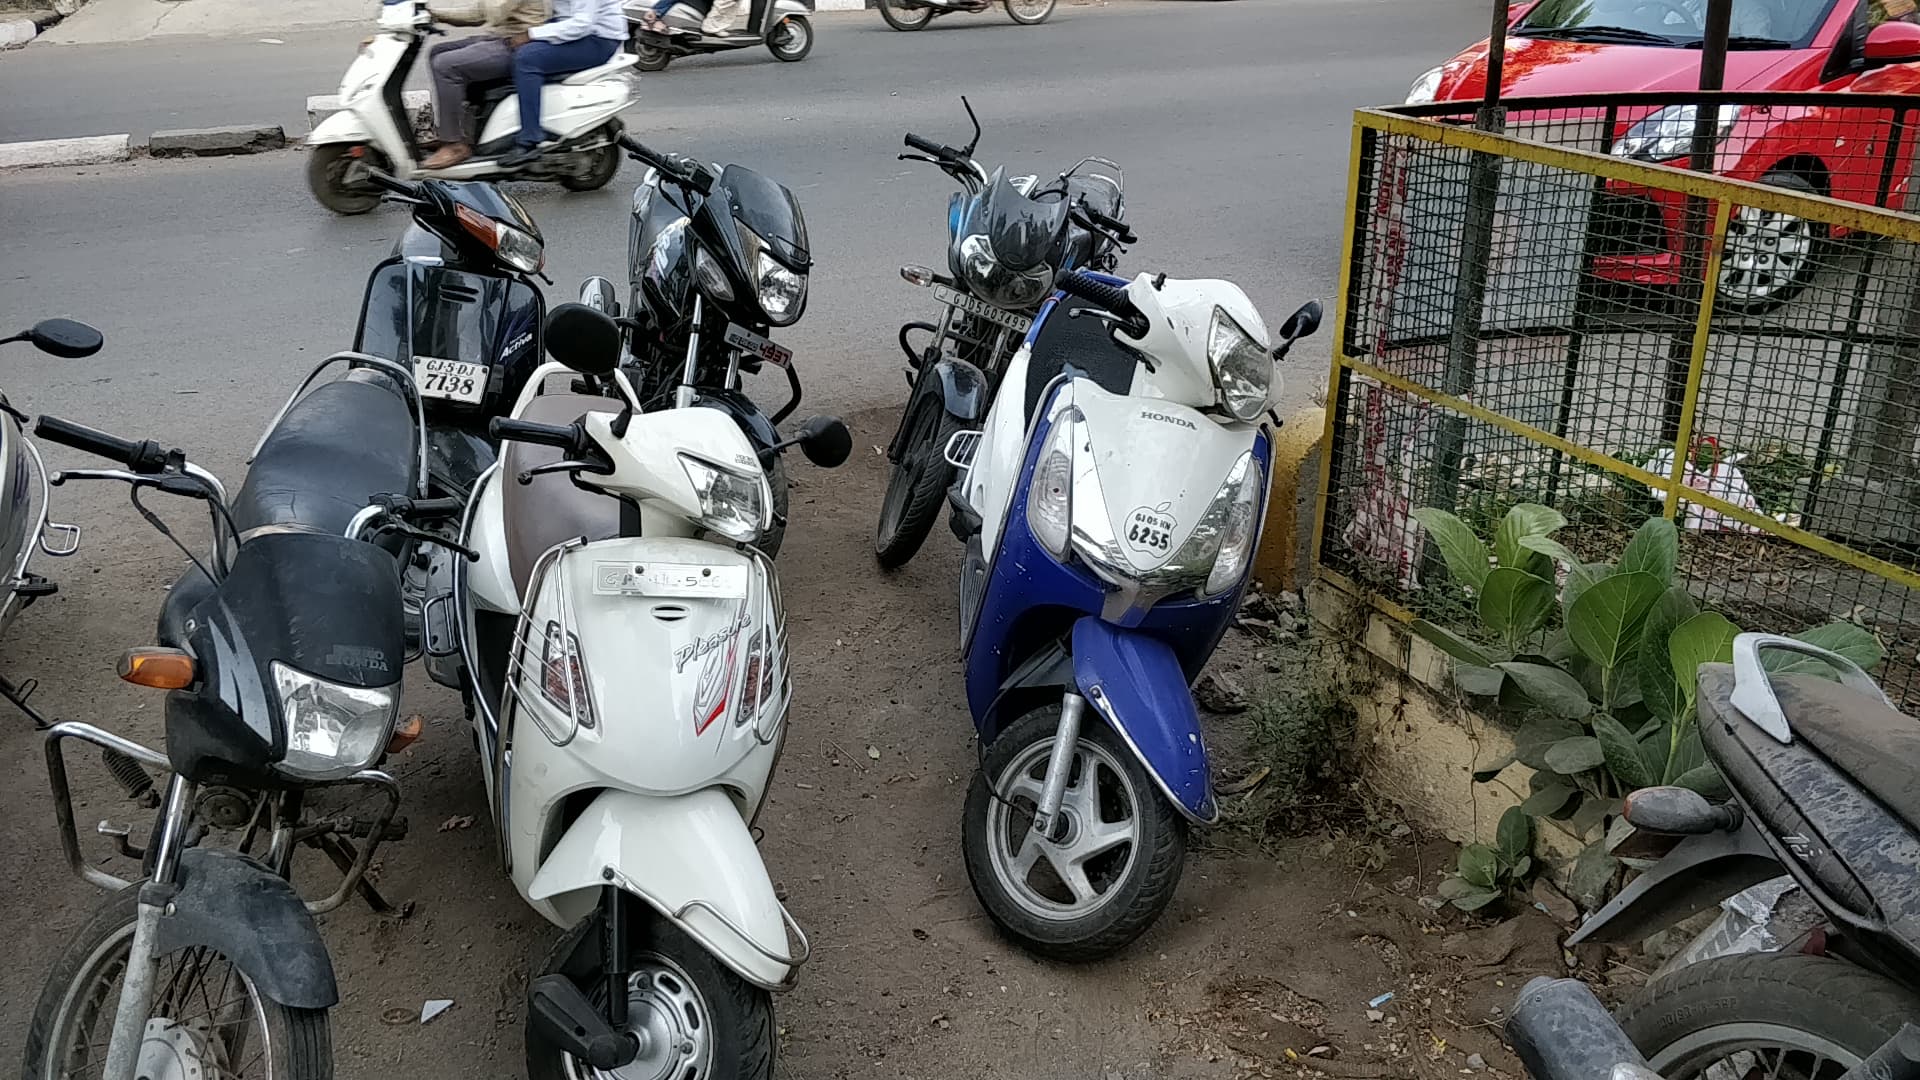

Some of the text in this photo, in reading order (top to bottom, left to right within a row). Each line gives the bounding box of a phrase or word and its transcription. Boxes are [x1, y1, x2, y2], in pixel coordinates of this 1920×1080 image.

[424, 373, 474, 396] 7138
[1141, 411, 1198, 431] HONDA
[1129, 523, 1169, 550] 6255
[674, 614, 752, 674] Pleasure
